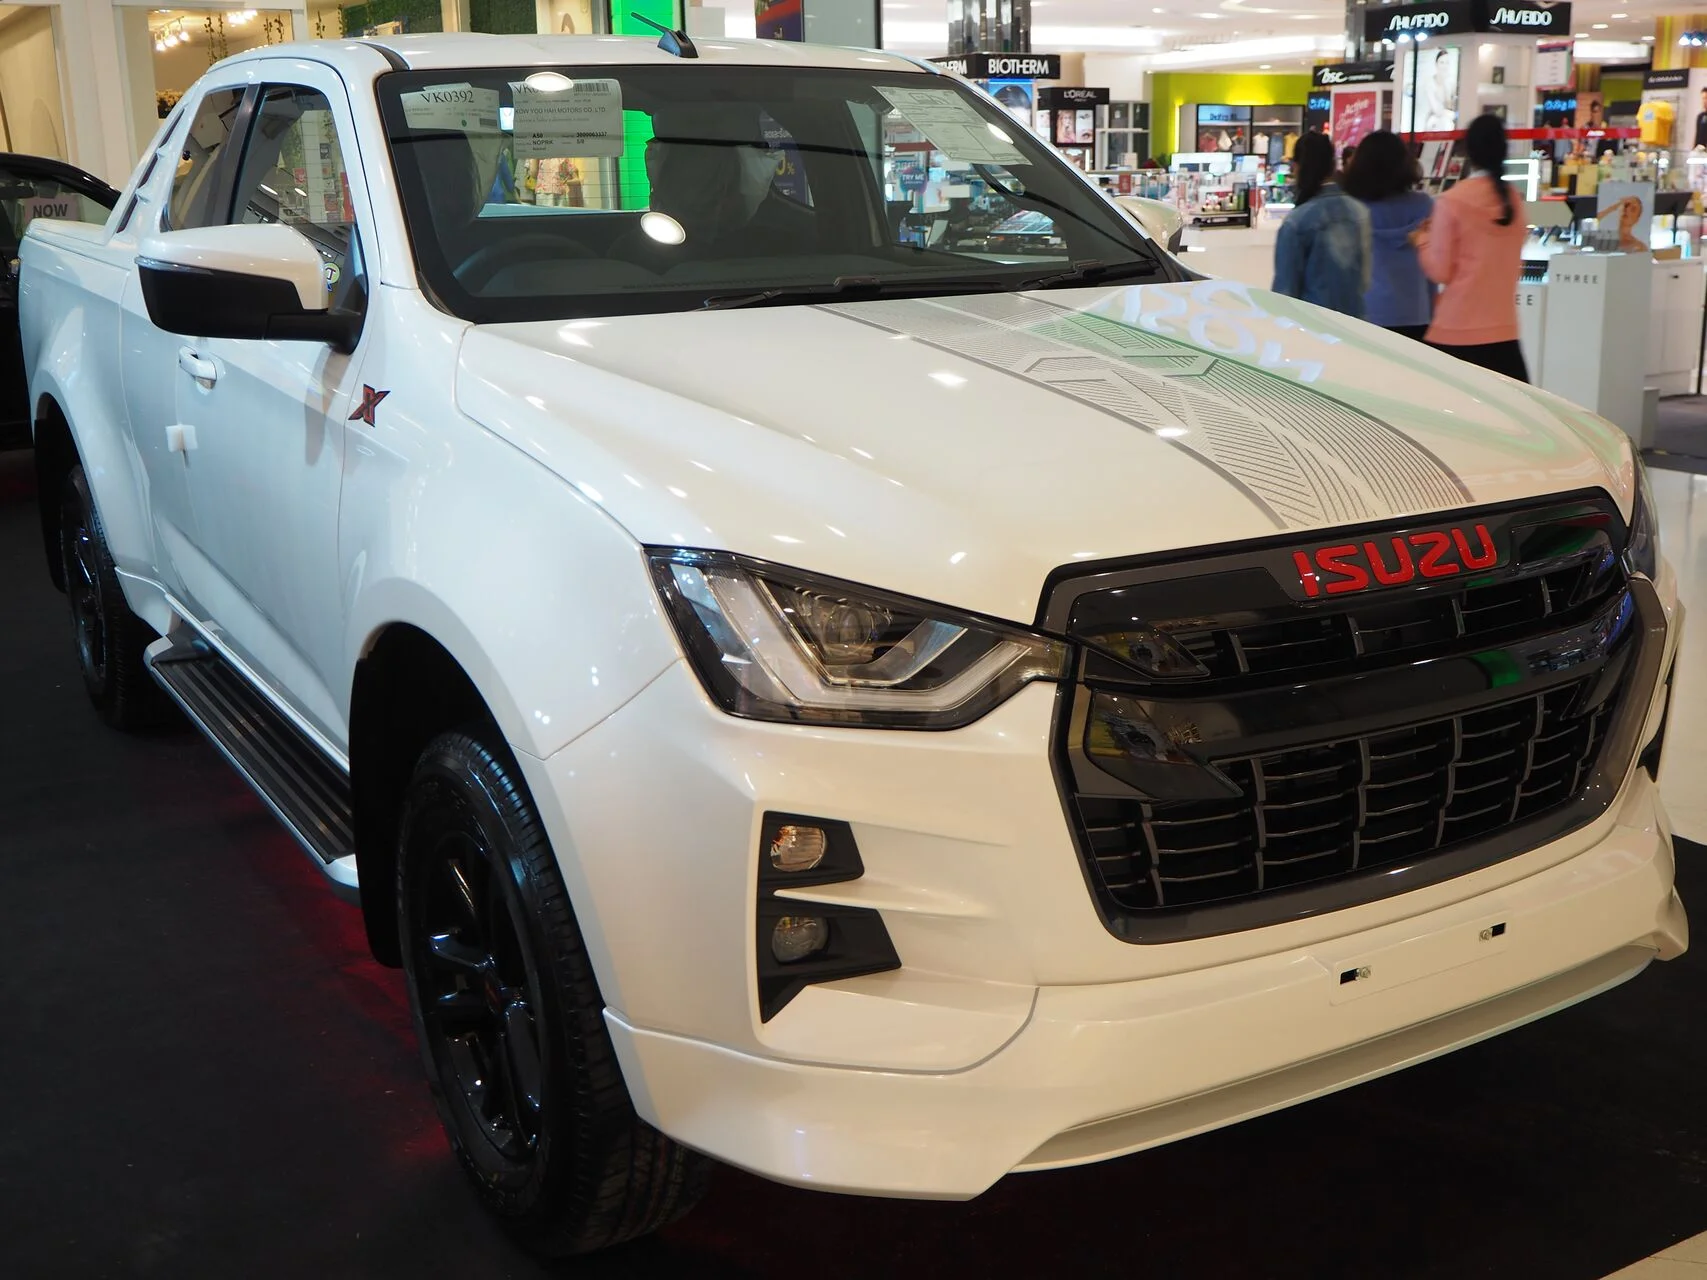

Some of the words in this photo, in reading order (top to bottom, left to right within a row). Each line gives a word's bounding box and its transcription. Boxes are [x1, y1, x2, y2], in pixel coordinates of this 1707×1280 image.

[1490, 7, 1553, 26] SHISEIDO
[988, 58, 1049, 75] BIOTHERM
[421, 90, 474, 103] VK0392
[32, 203, 68, 218] NOW
[1556, 273, 1599, 285] THREE
[1292, 524, 1498, 598] ISUZU
